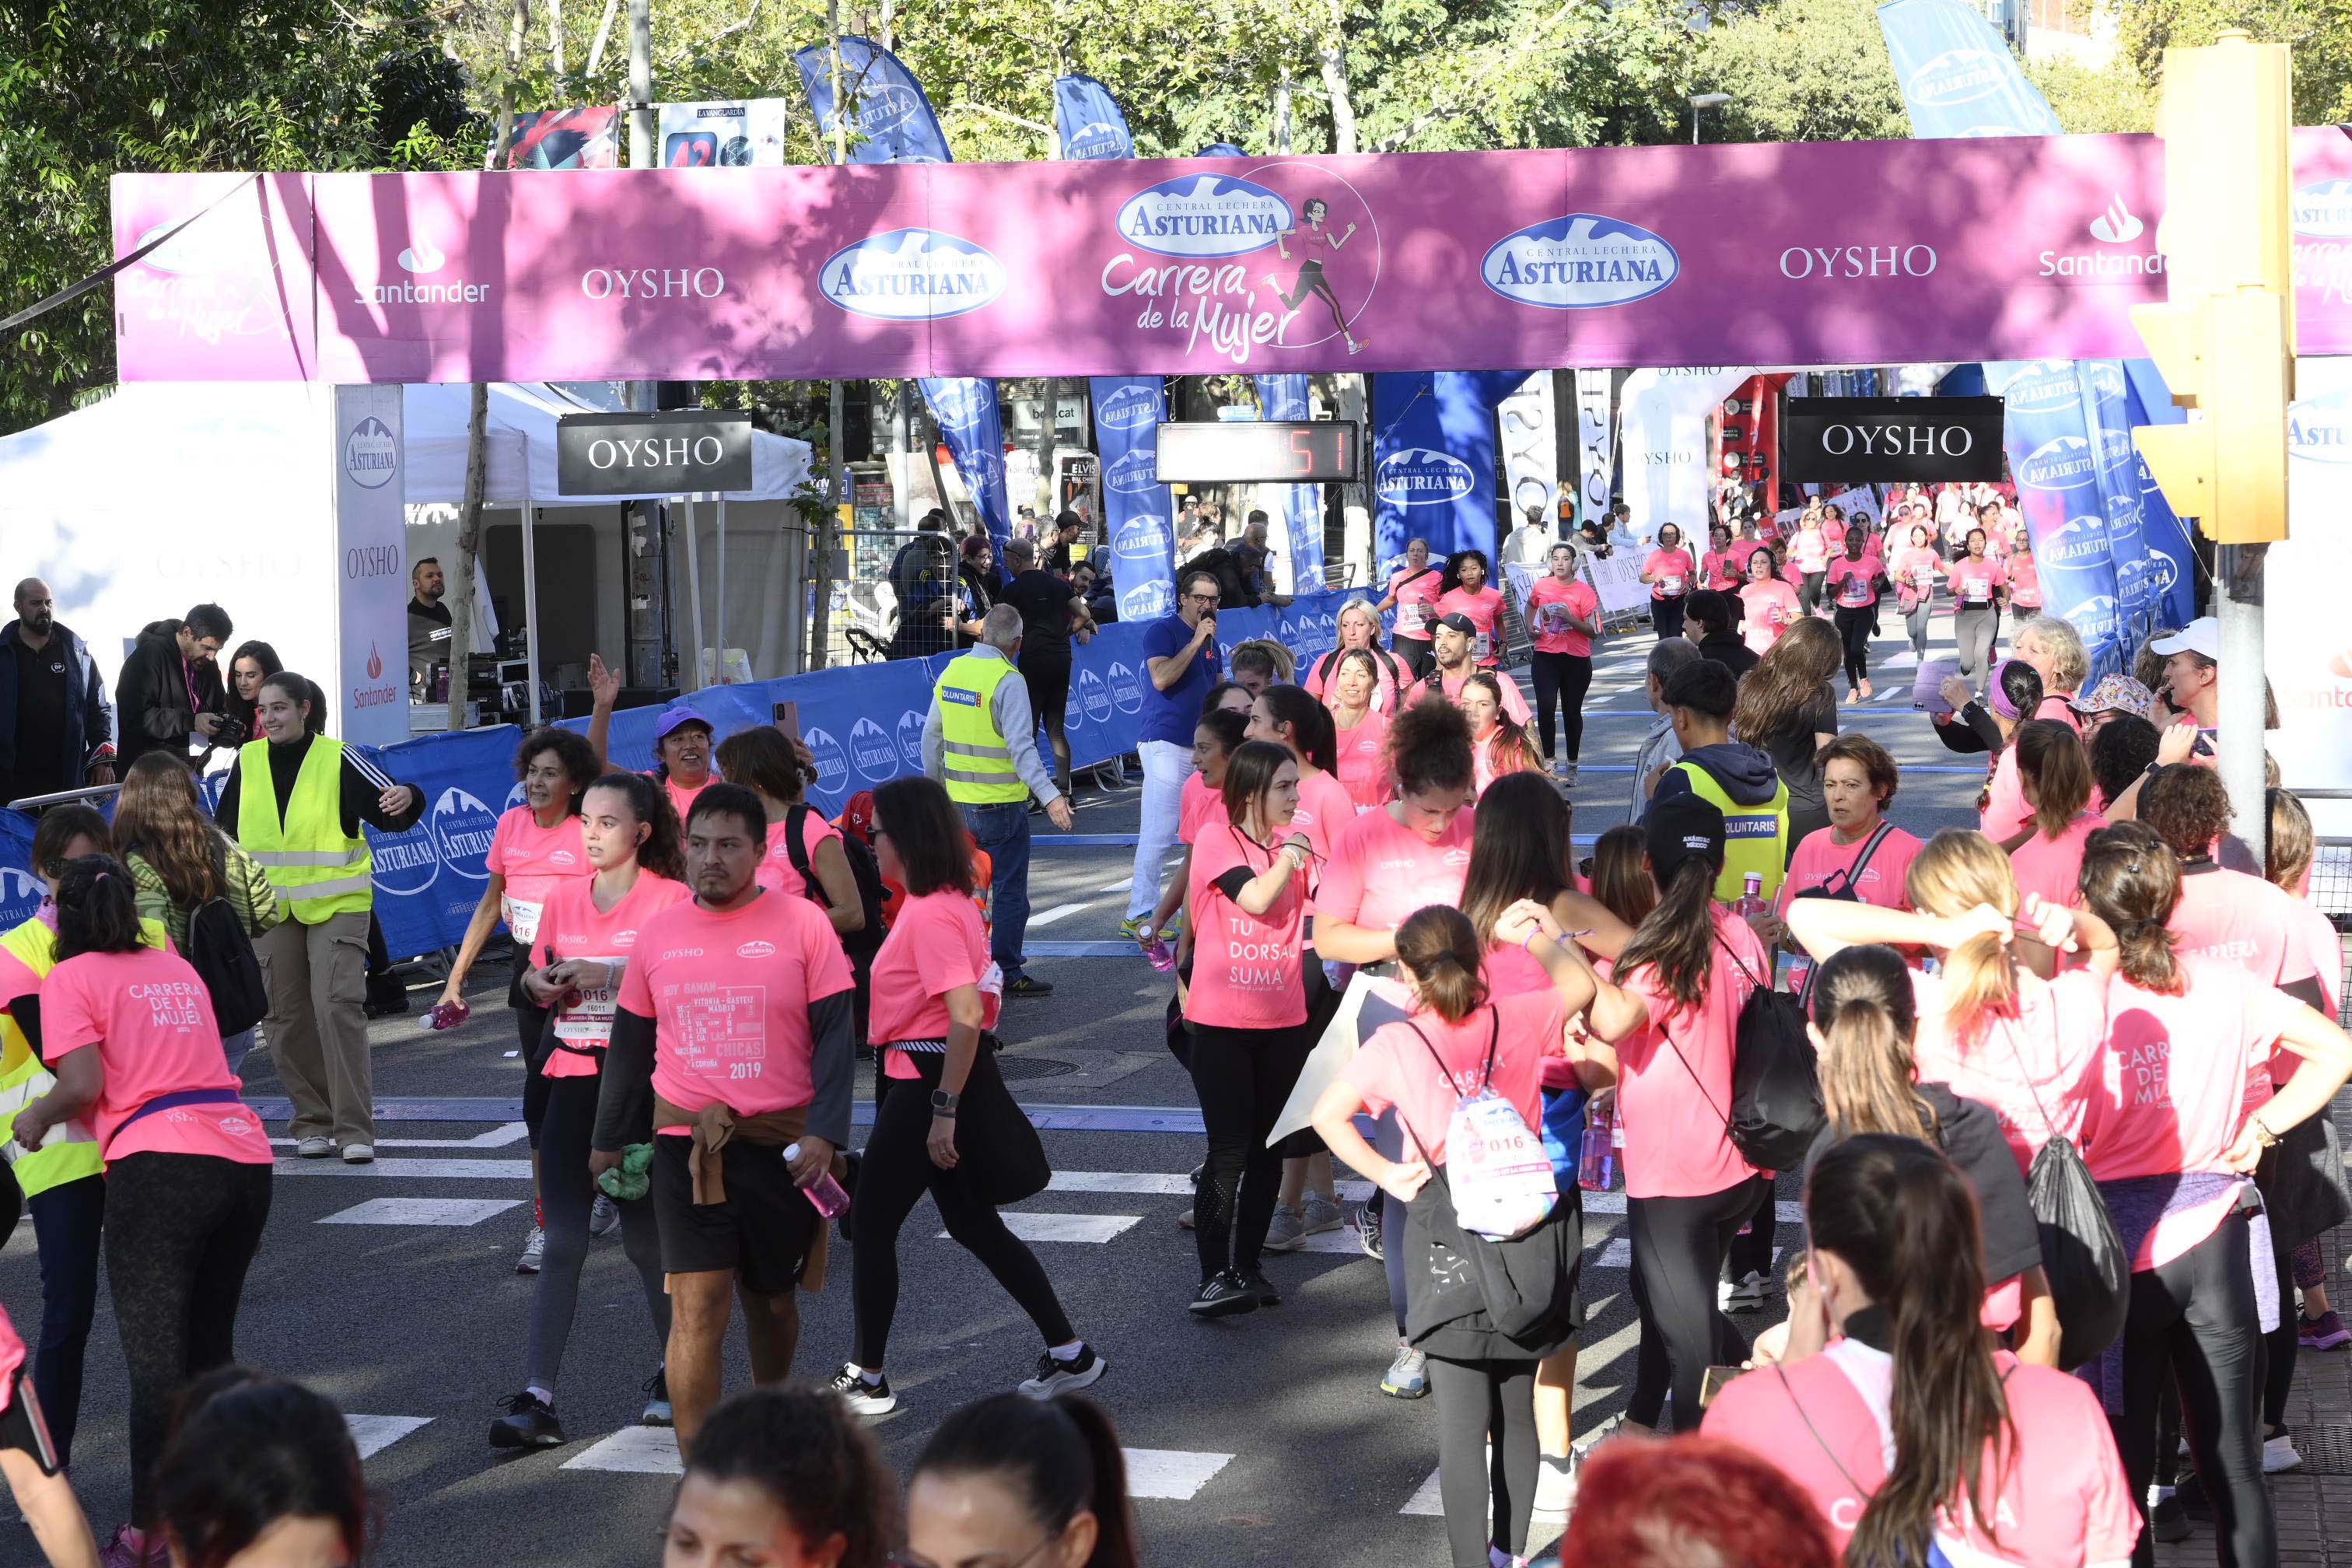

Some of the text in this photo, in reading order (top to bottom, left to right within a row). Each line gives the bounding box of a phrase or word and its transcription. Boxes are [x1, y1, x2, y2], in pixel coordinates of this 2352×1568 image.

[1157, 201, 1274, 211] CENTRAL LECHERA
[1130, 205, 1279, 236] ASTURIANA
[1527, 246, 1658, 257] CENTRAL LECHERA
[1780, 244, 1937, 278] OYSHO
[1101, 254, 1246, 296] Carrera
[1496, 250, 1664, 285] ASTURIANA
[581, 267, 725, 299] OYSHO
[833, 262, 990, 296] ASTURIANA
[355, 280, 490, 303] Santander
[1137, 292, 1301, 364] de la Mujer
[1822, 425, 1973, 457] OYSHO
[350, 444, 394, 471] ASTURIANA
[588, 436, 723, 470] OYSHO
[1072, 464, 1097, 473] ELVIS
[1379, 471, 1467, 492] ASTURIANA
[347, 544, 399, 579] OYSHO
[354, 684, 397, 709] Santander
[1083, 691, 1109, 711] ASTURIANA
[1112, 684, 1140, 702] ASTURIANA
[854, 744, 897, 768] ASTURIANA
[814, 756, 847, 778] STURIANA
[446, 816, 492, 830] CENTRAL LECHERA
[1725, 821, 1776, 834] OLUNTARIS
[371, 828, 424, 843] CENTRAL LECHERA
[439, 825, 496, 859] ASTURIAN
[1230, 918, 1253, 936] TU
[663, 948, 704, 961] OYSHO
[1230, 942, 1295, 961] DORSAL
[1229, 965, 1283, 985] SUMA
[129, 982, 203, 999] CARRERA
[583, 989, 608, 1002] 016
[684, 982, 716, 994] GANAN
[150, 996, 196, 1011] DE LA
[587, 1004, 606, 1013] 16011
[694, 996, 720, 1006] VITORIA
[726, 996, 754, 1004] GASTEIZ
[153, 1010, 203, 1027] MUJER
[710, 1031, 726, 1041] LAS
[716, 1042, 761, 1057] CHICAS
[730, 1062, 762, 1080] 2019
[2137, 1062, 2164, 1086] DE
